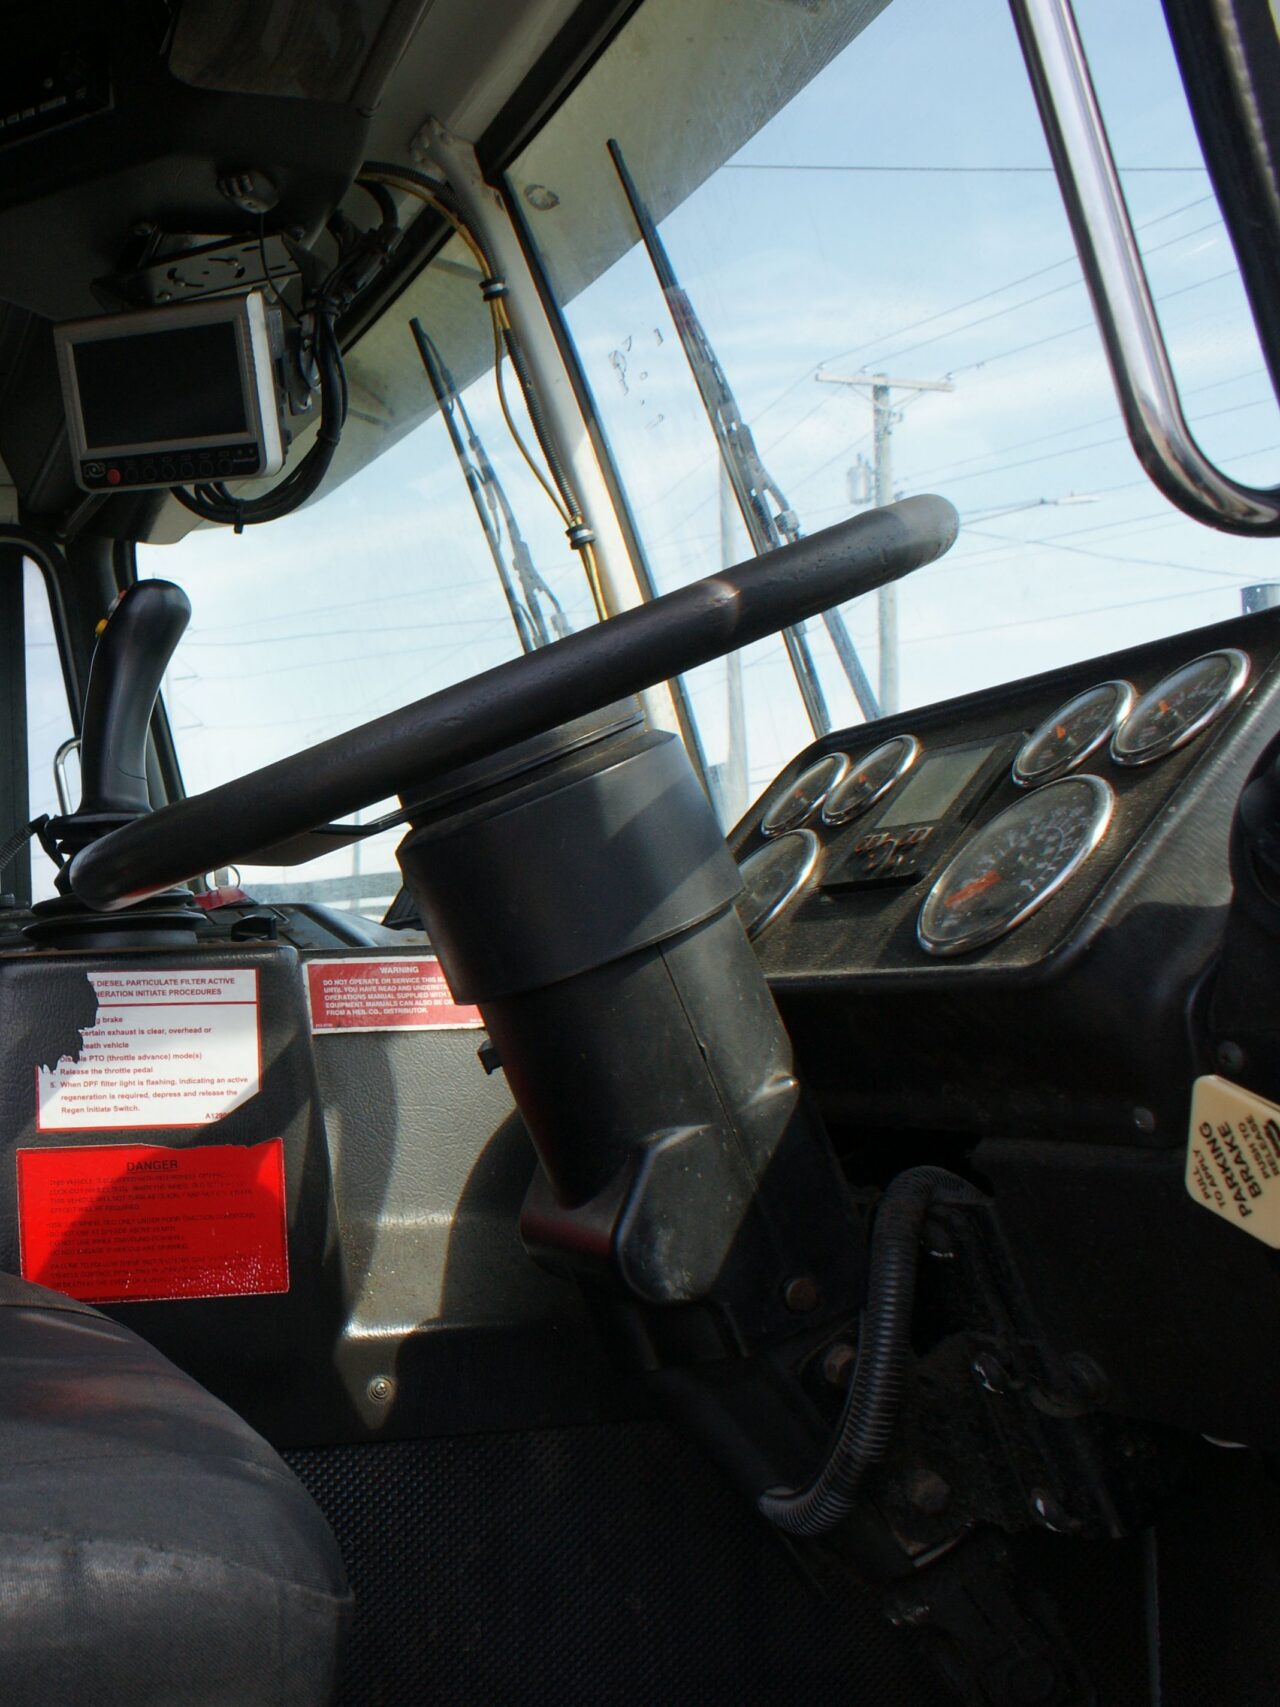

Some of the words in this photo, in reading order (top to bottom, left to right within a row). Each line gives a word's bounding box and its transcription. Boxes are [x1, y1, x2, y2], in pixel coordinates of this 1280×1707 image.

[379, 966, 420, 974] WARNING
[126, 978, 179, 987] PARTICULATE
[207, 977, 235, 985] ACTIVE
[135, 989, 167, 997] INITIATE
[168, 988, 222, 996] PROCEDURES
[366, 1000, 398, 1008] MANUALS
[106, 1054, 136, 1062] (throttle
[137, 1053, 171, 1061] advance)
[172, 1052, 202, 1061] mode(s)
[133, 1067, 153, 1075] pedal
[119, 1079, 136, 1088] light
[179, 1077, 215, 1085] indicating
[61, 1094, 107, 1102] regeneration
[152, 1091, 181, 1100] depress
[61, 1106, 85, 1115] Regen
[113, 1104, 140, 1113] Switch.
[1238, 1122, 1250, 1139] TO
[1245, 1114, 1279, 1176] RELEASE
[127, 1159, 178, 1171] DANGER
[1217, 1121, 1263, 1199] BRAKE
[1248, 1142, 1271, 1179] PUSH
[1193, 1149, 1217, 1187] APPLY
[1199, 1121, 1253, 1217] PARKING
[1192, 1167, 1211, 1200] PULL
[1214, 1190, 1226, 1208] TO
